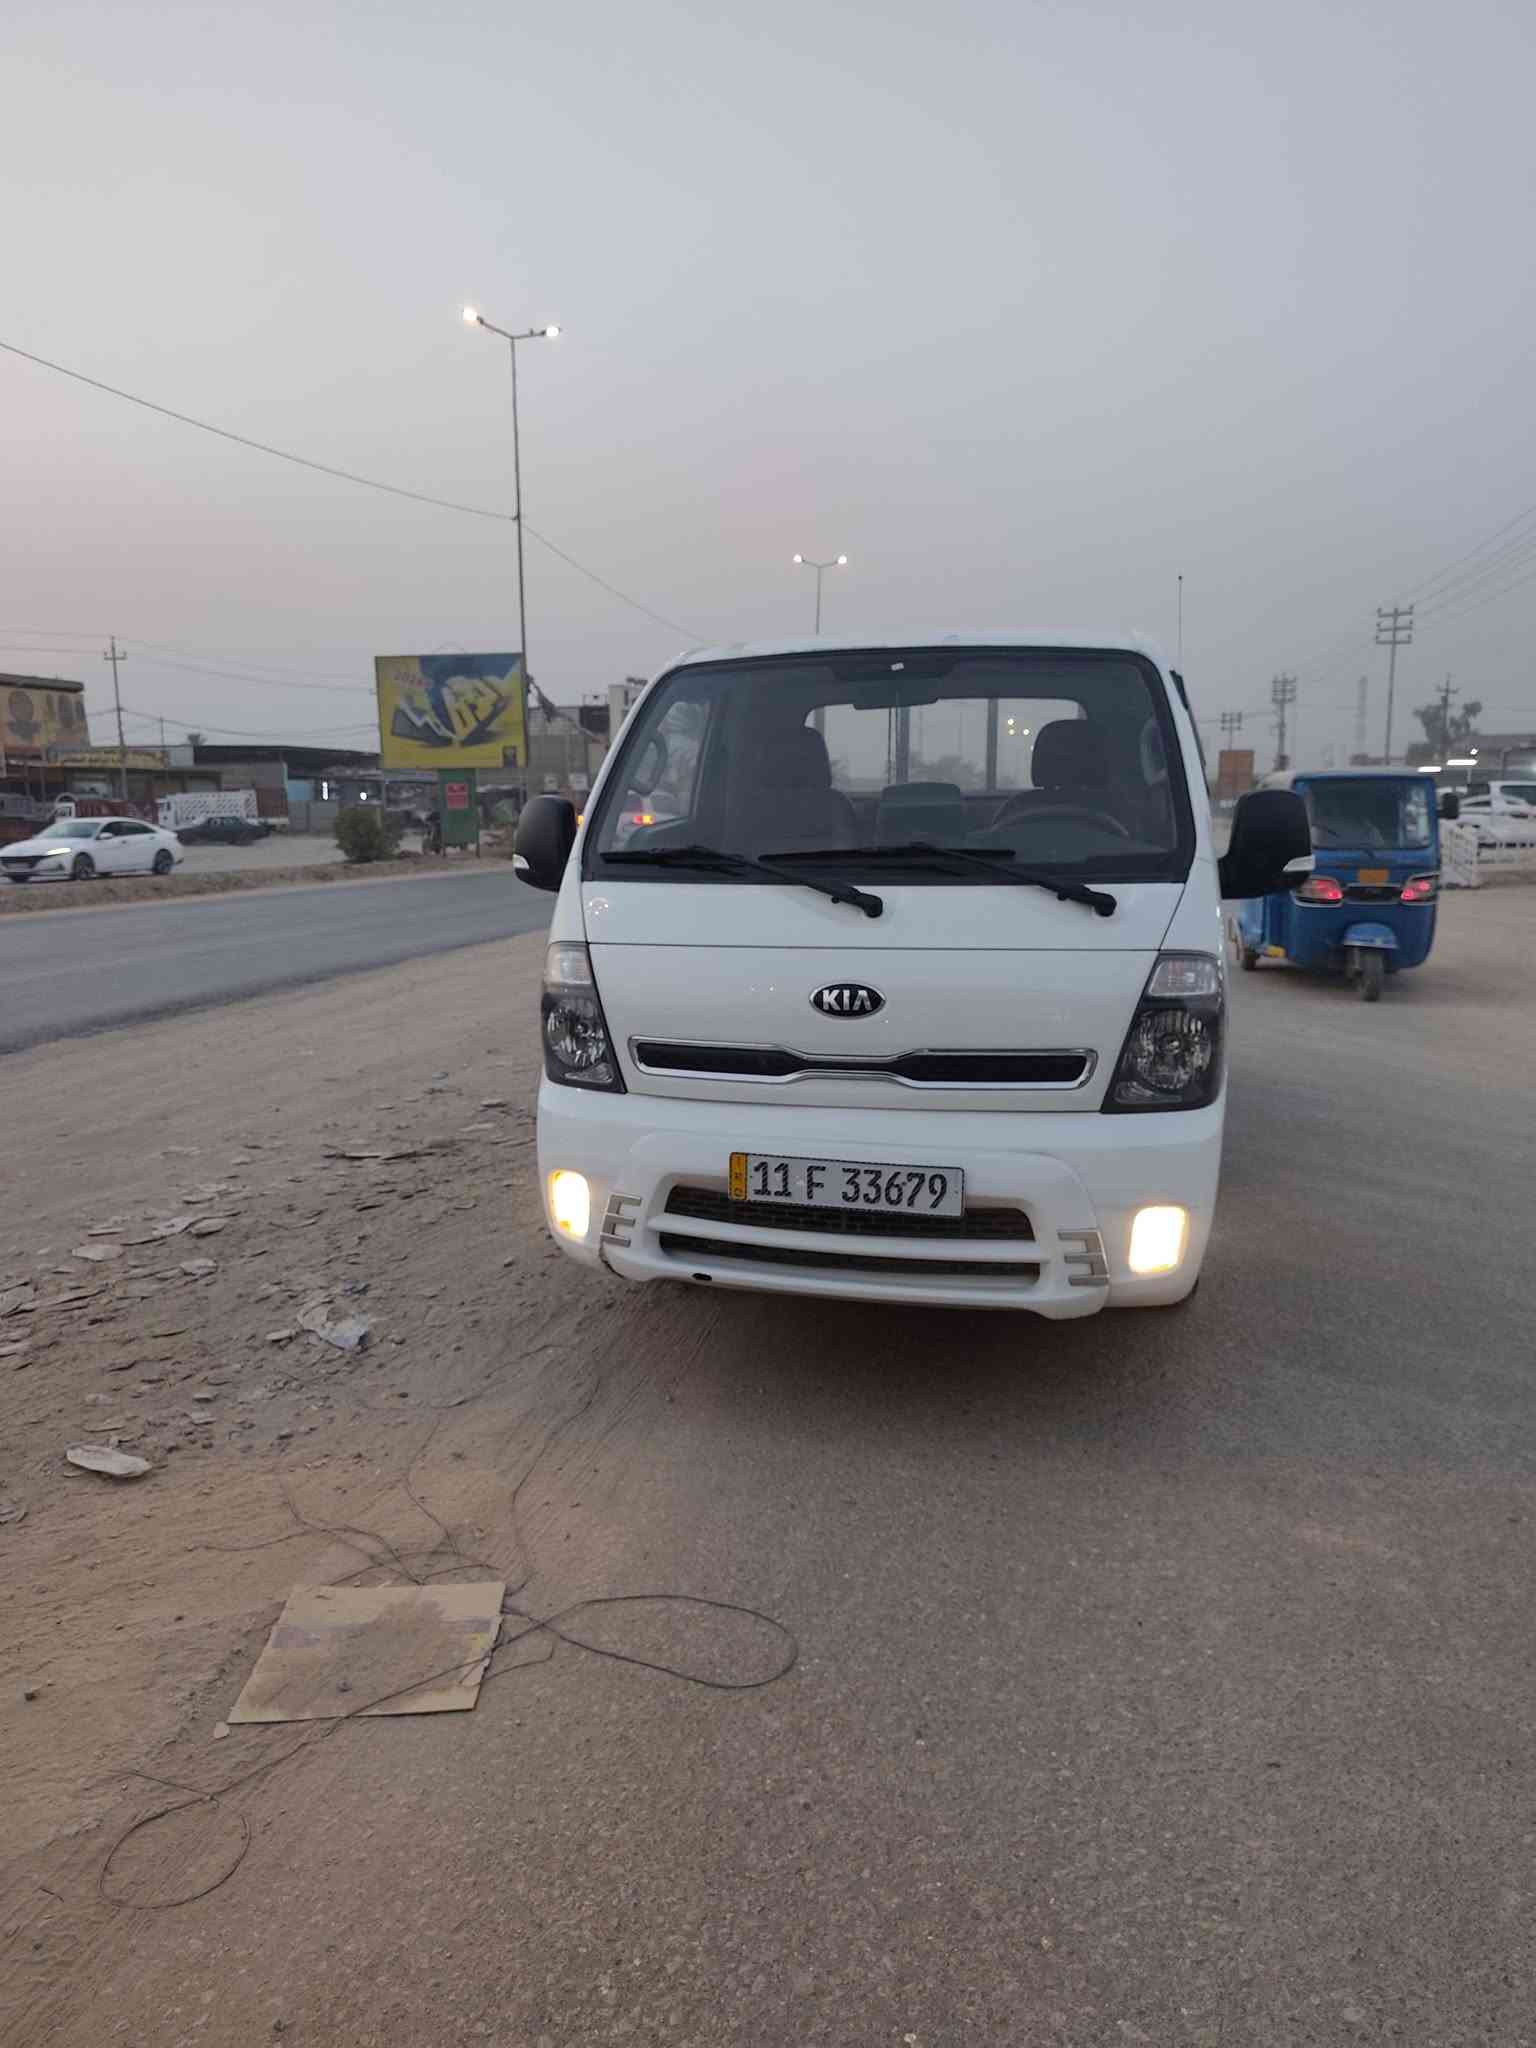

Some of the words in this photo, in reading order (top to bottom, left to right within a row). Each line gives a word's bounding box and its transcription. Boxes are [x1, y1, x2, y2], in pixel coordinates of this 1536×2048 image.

[822, 989, 872, 1011] KIA
[753, 1161, 792, 1197] 11
[806, 1165, 826, 1200] F
[841, 1168, 948, 1209] 33679
